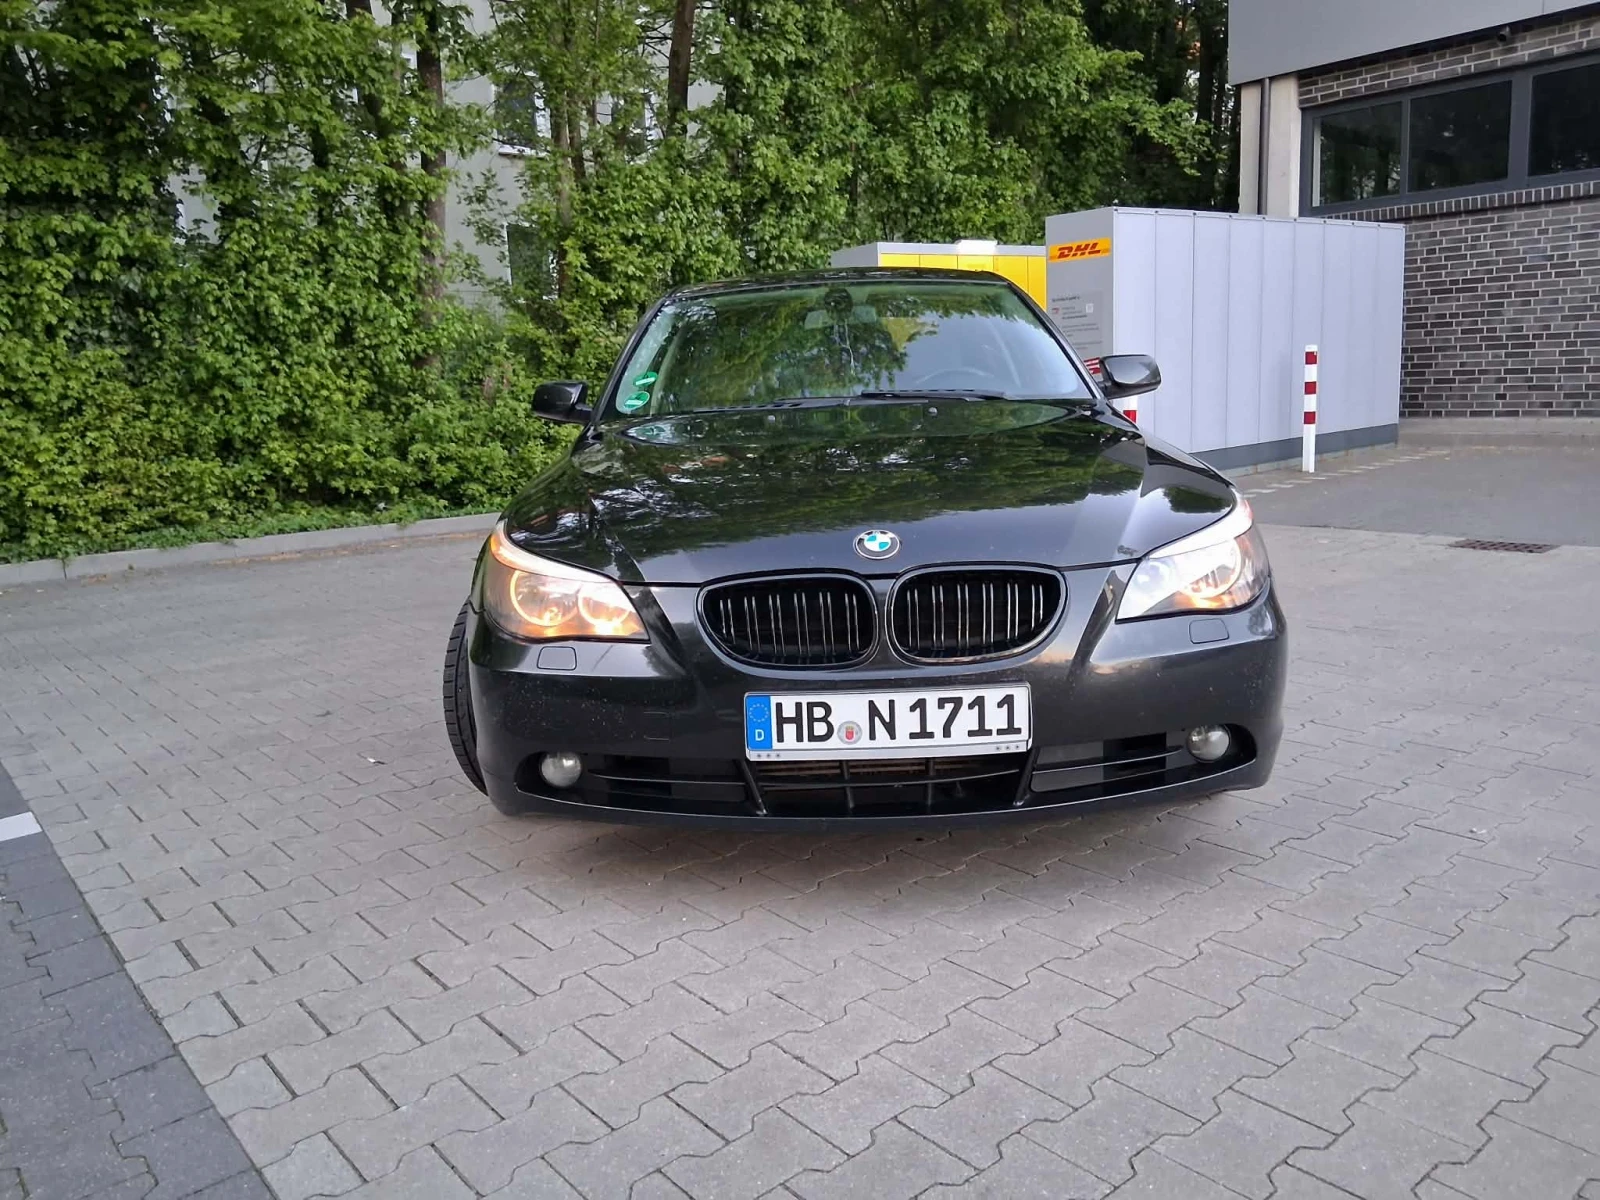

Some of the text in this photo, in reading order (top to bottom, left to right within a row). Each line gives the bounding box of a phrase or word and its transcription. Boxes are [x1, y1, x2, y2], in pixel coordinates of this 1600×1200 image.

[1057, 242, 1101, 259] DHL
[775, 694, 1022, 743] HB N 1711
[755, 729, 765, 741] D
